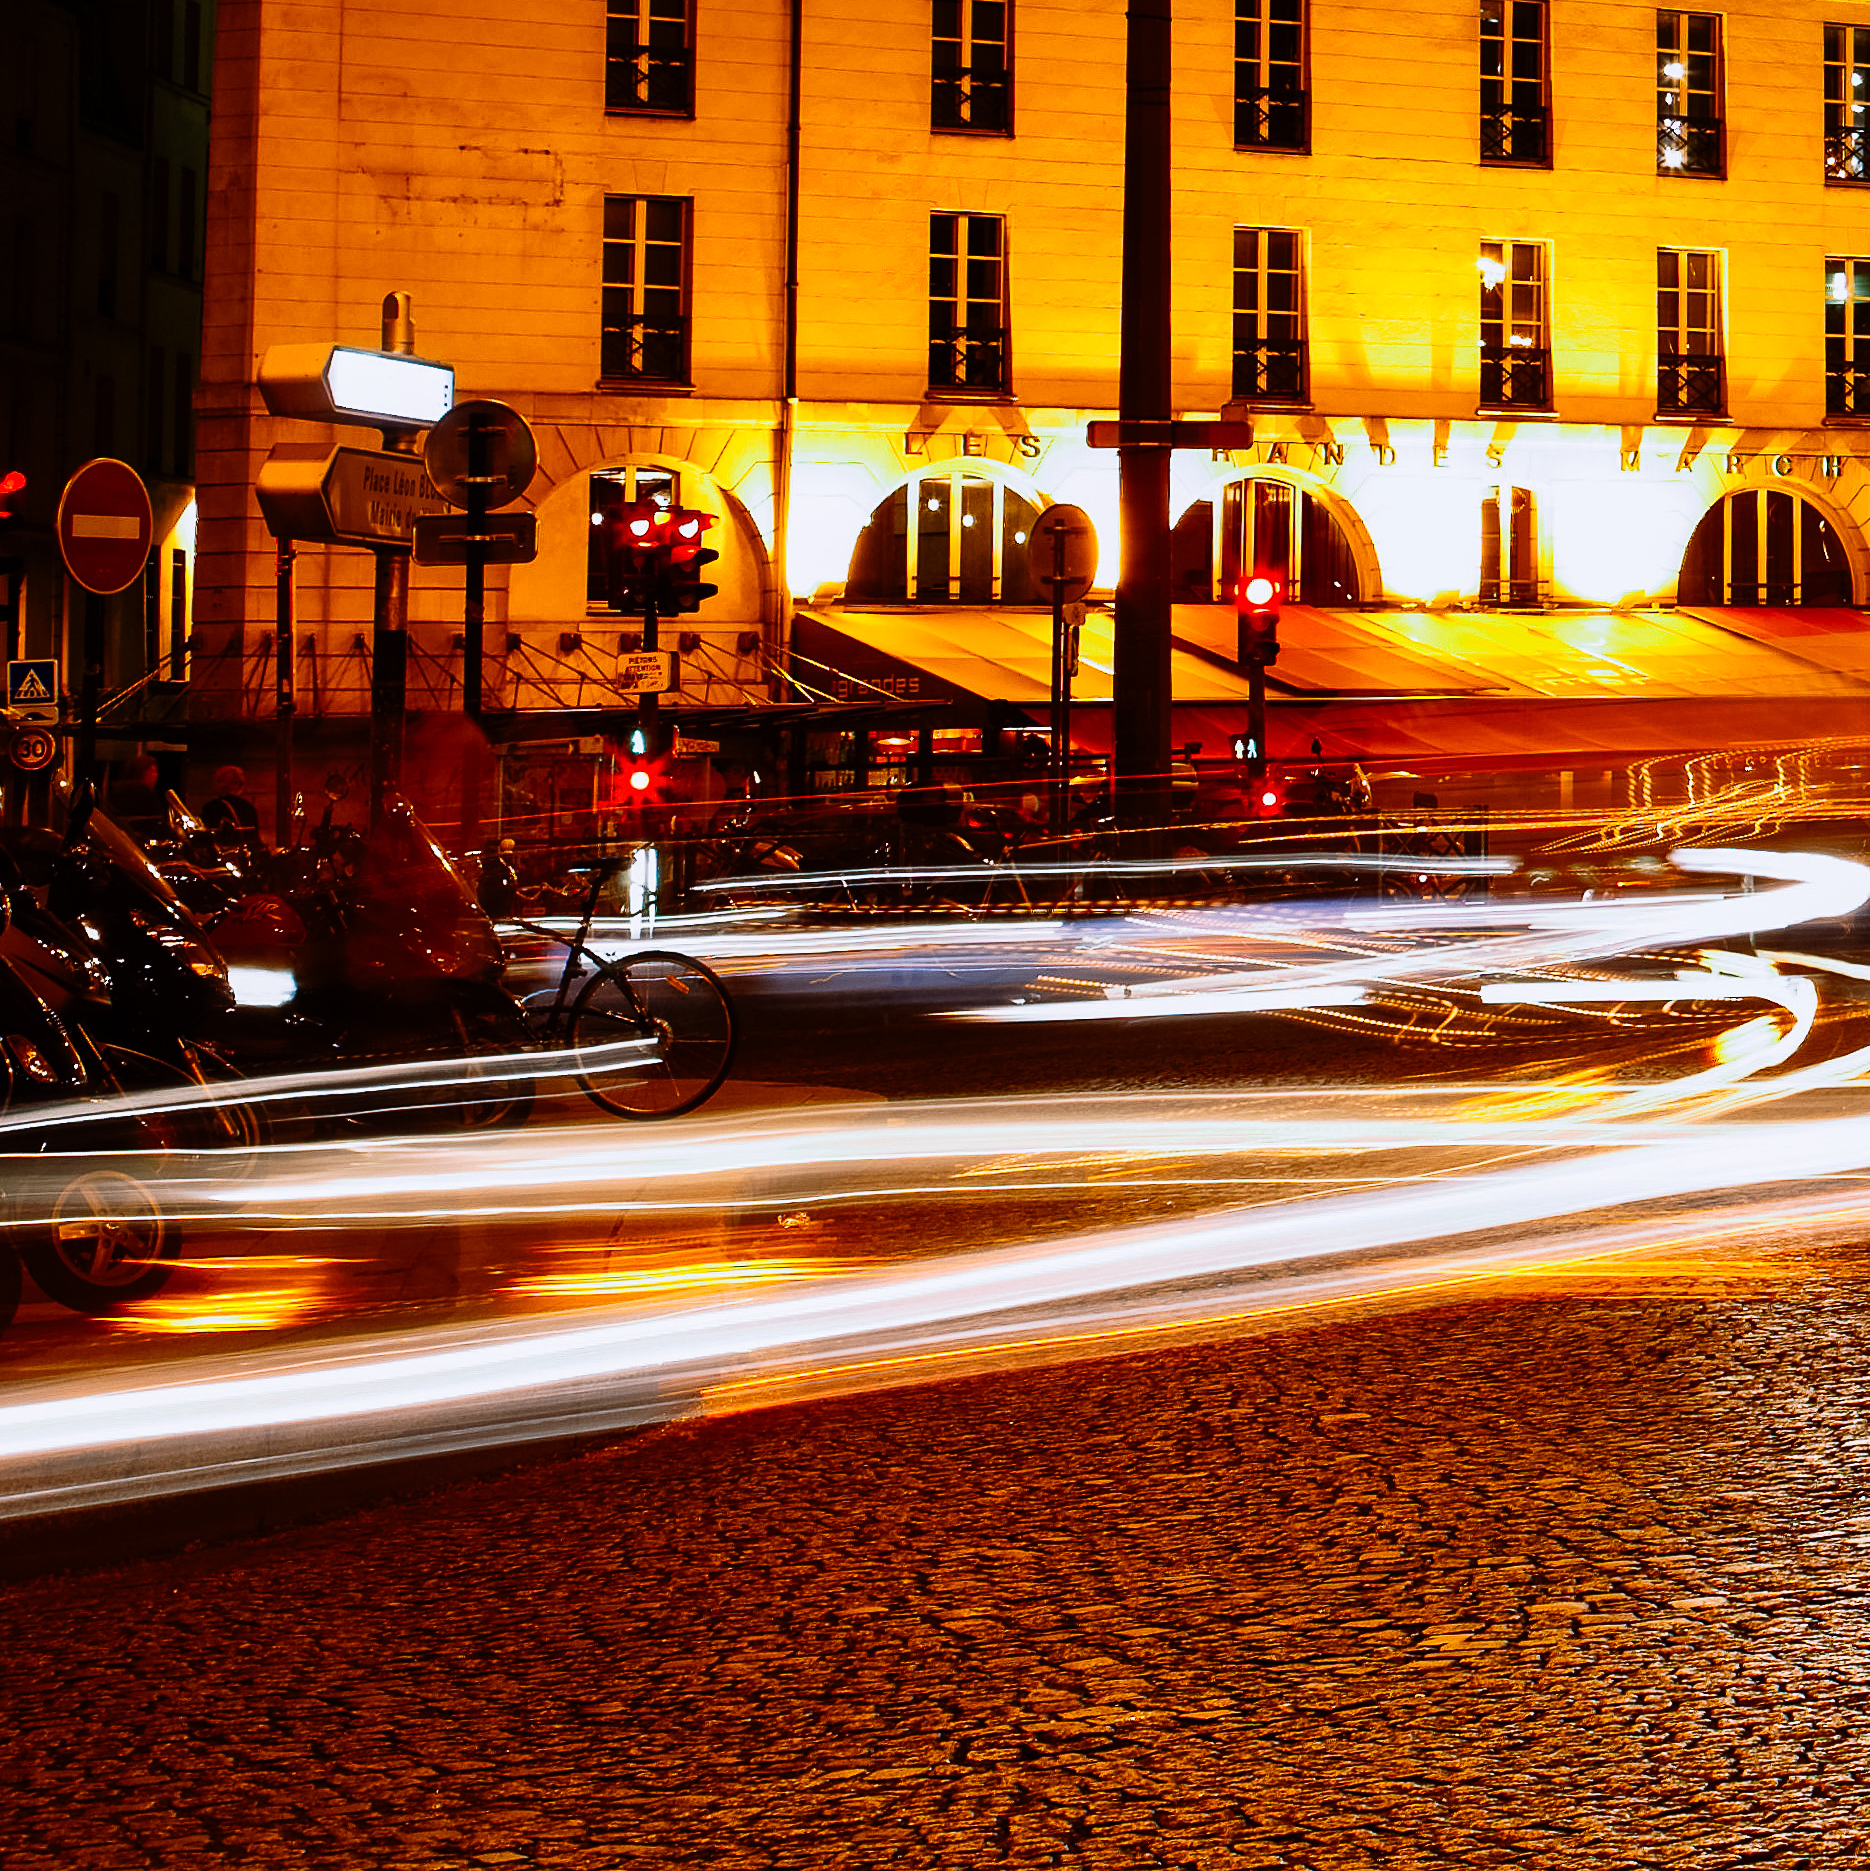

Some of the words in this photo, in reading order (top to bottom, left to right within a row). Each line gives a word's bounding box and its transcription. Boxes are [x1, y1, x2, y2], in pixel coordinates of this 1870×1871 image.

[904, 432, 1041, 458] LES
[1212, 441, 1503, 468] RANDES
[362, 465, 391, 493] Place
[369, 500, 402, 528] Mairie
[838, 673, 919, 698] grandes
[20, 739, 45, 758] 30
